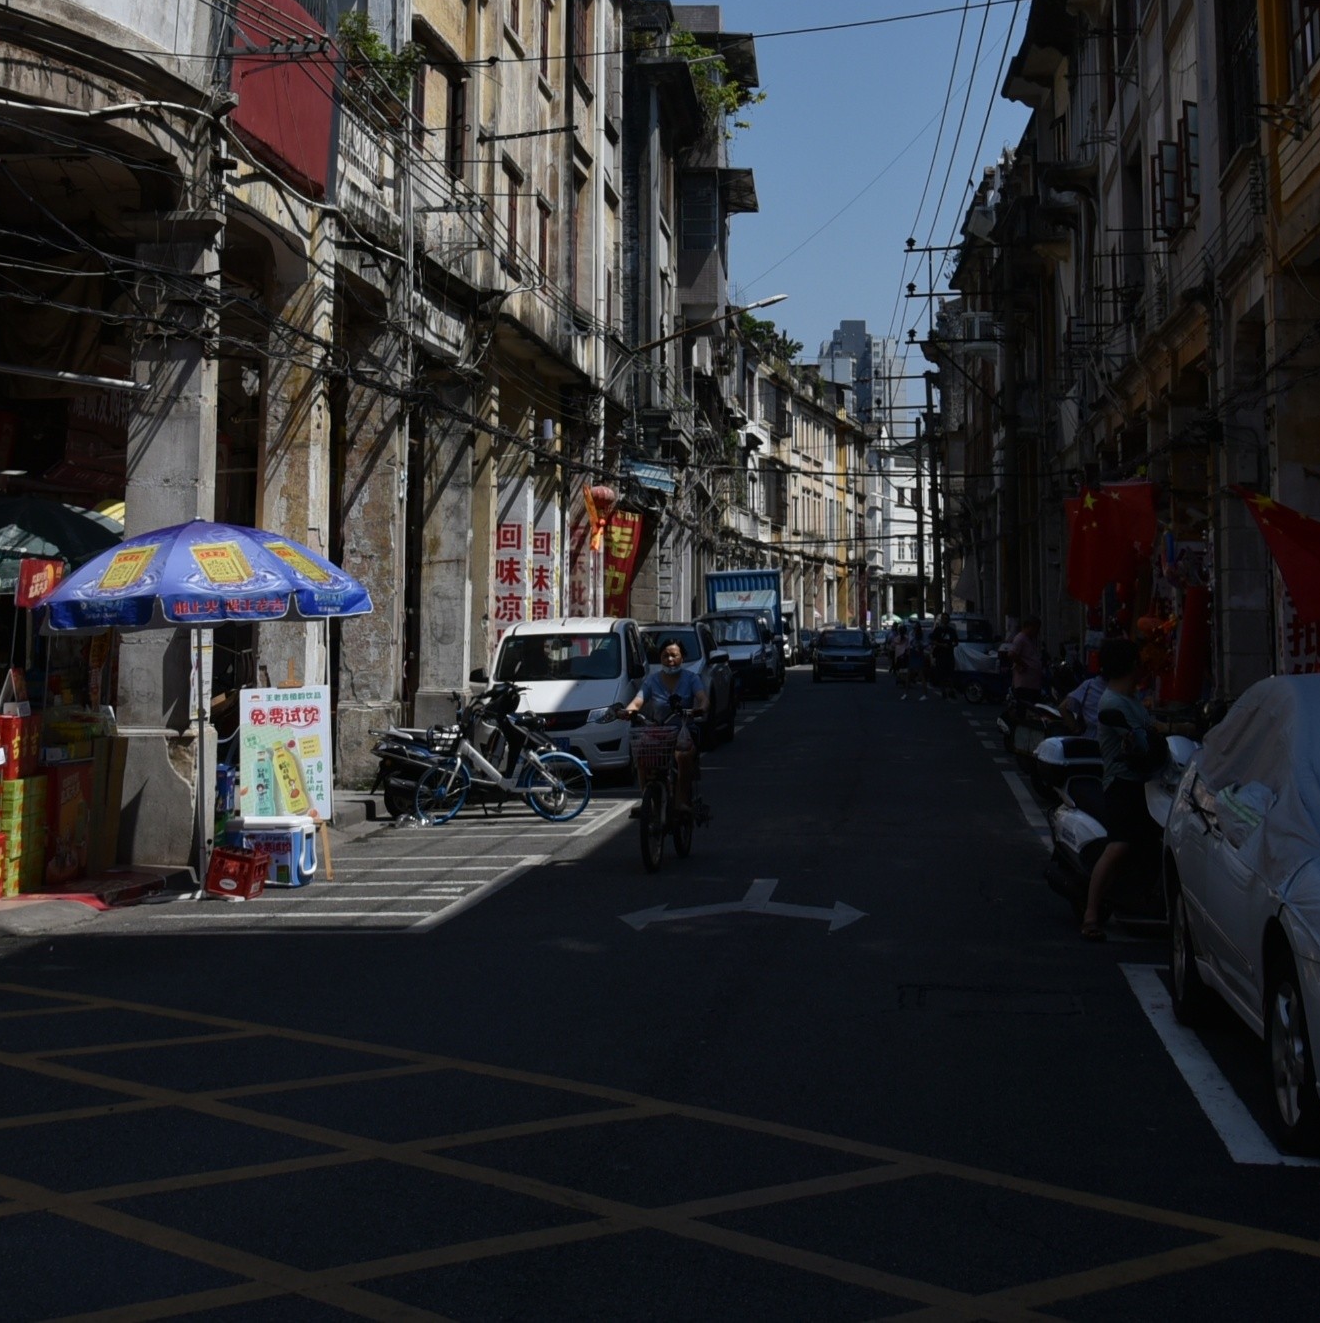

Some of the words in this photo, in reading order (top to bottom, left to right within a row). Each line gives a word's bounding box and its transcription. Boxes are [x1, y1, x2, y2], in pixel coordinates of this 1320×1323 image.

[495, 523, 523, 644] 回味凉
[250, 706, 320, 726] 免费试饮
